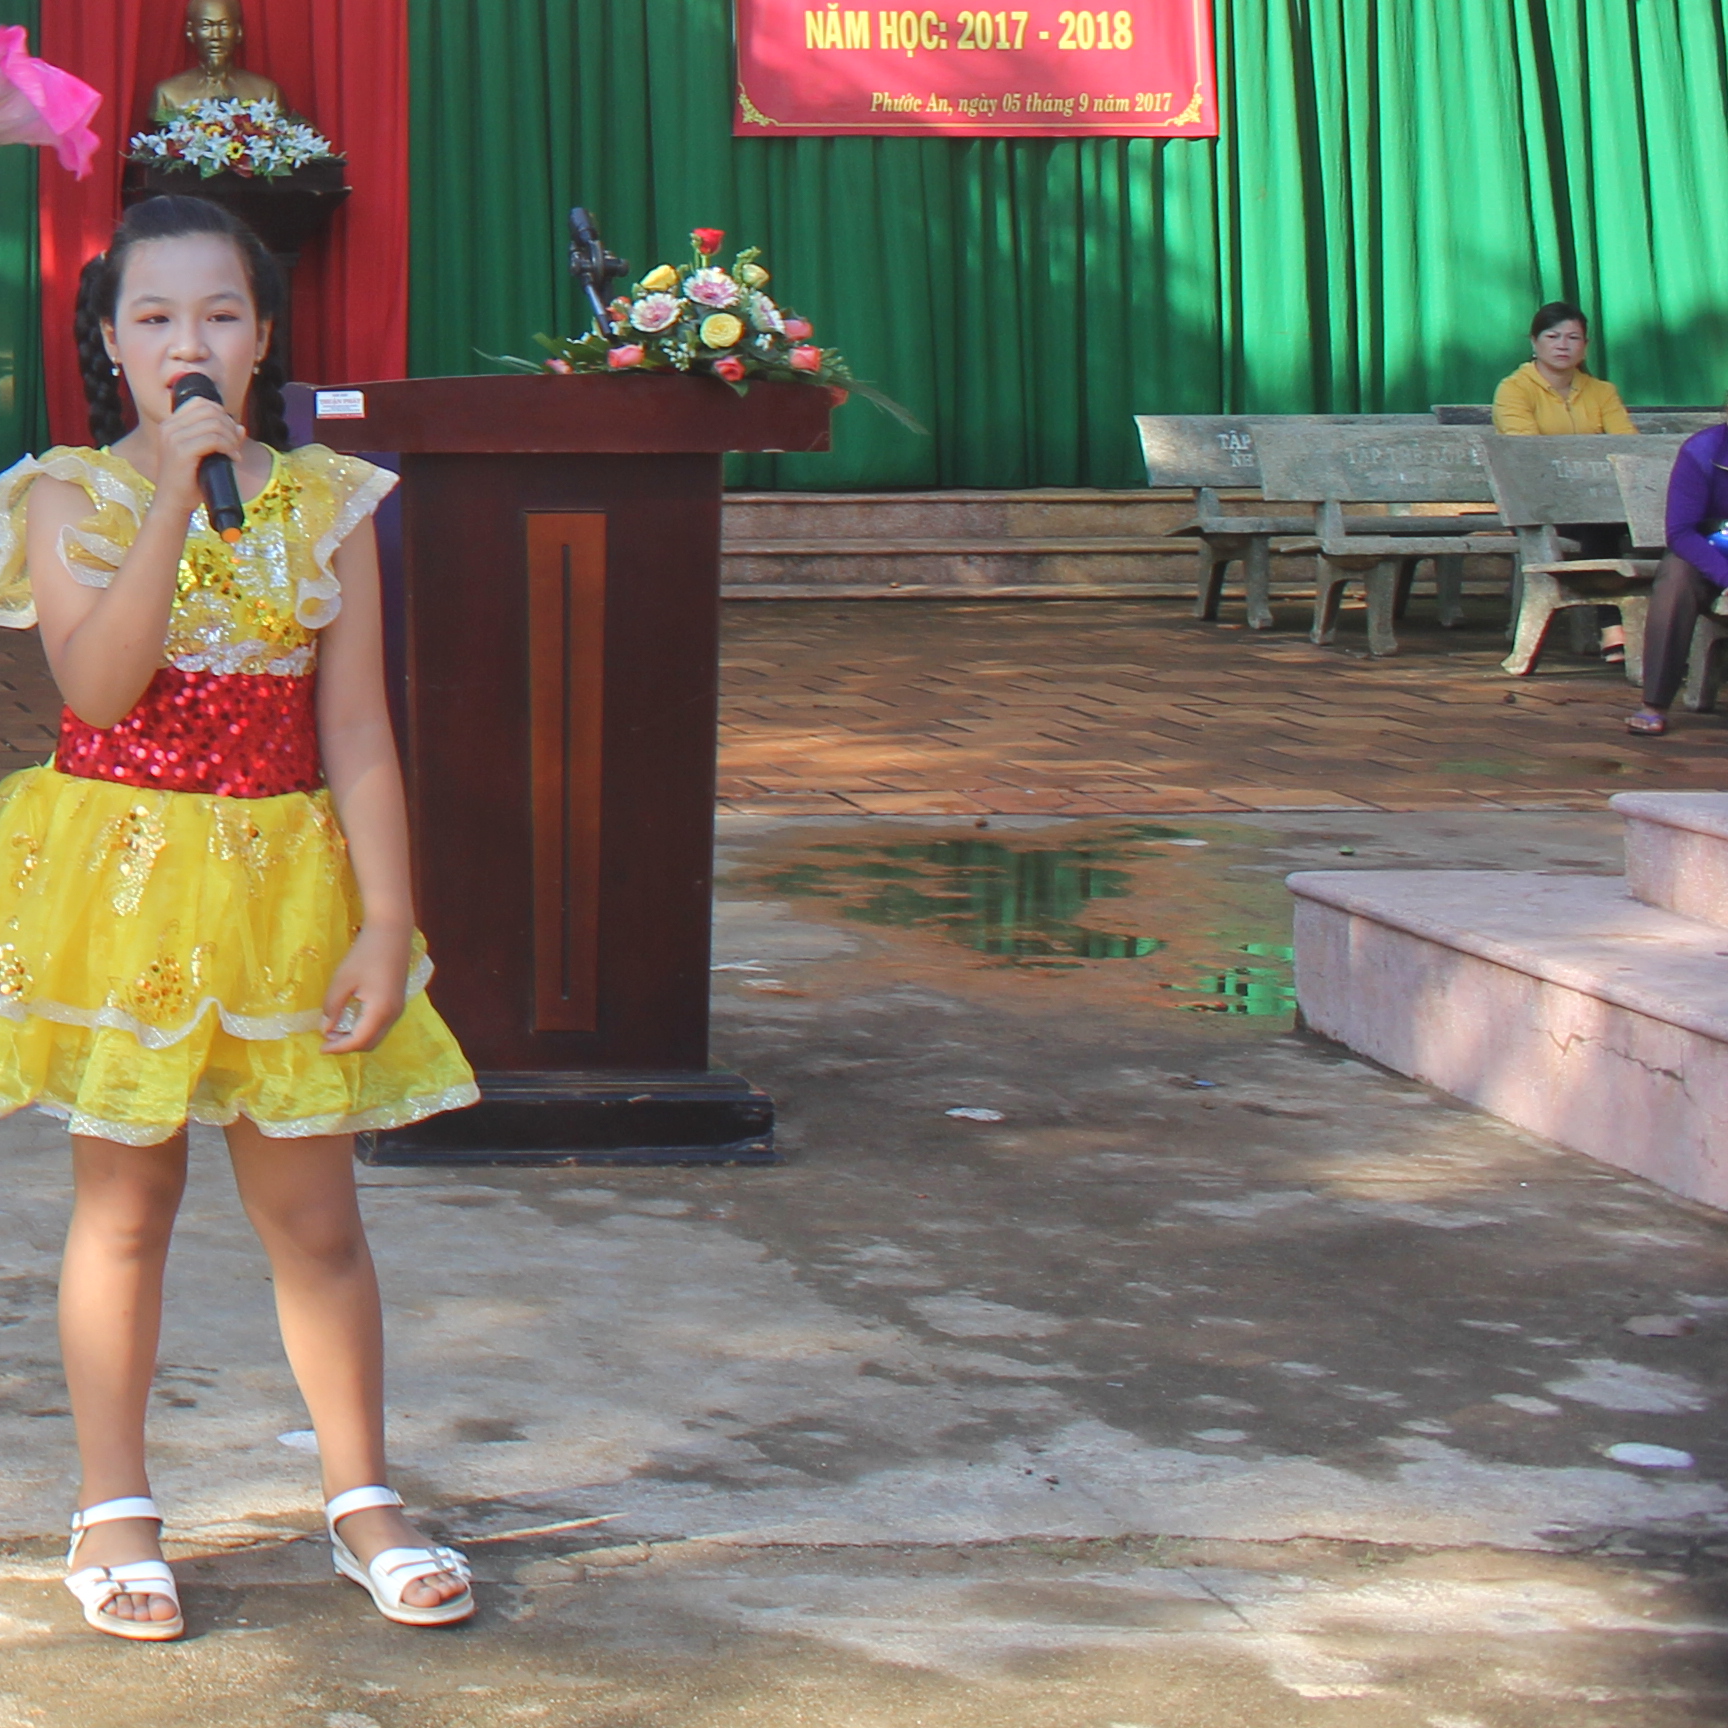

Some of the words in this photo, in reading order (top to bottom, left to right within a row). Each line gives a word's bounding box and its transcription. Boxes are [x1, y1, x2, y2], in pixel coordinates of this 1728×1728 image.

[805, 2, 870, 50] NĂM
[879, 10, 948, 58] HỌC:
[956, 10, 1029, 51] 2017
[1058, 10, 1134, 51] 2018
[869, 91, 922, 113] Phước
[925, 92, 953, 116] An,
[957, 92, 998, 117] ngày
[1002, 92, 1021, 113] 05
[1025, 91, 1074, 117] tháng
[1078, 92, 1089, 113] 9
[1093, 92, 1130, 113] năm
[1134, 92, 1173, 113] 2017
